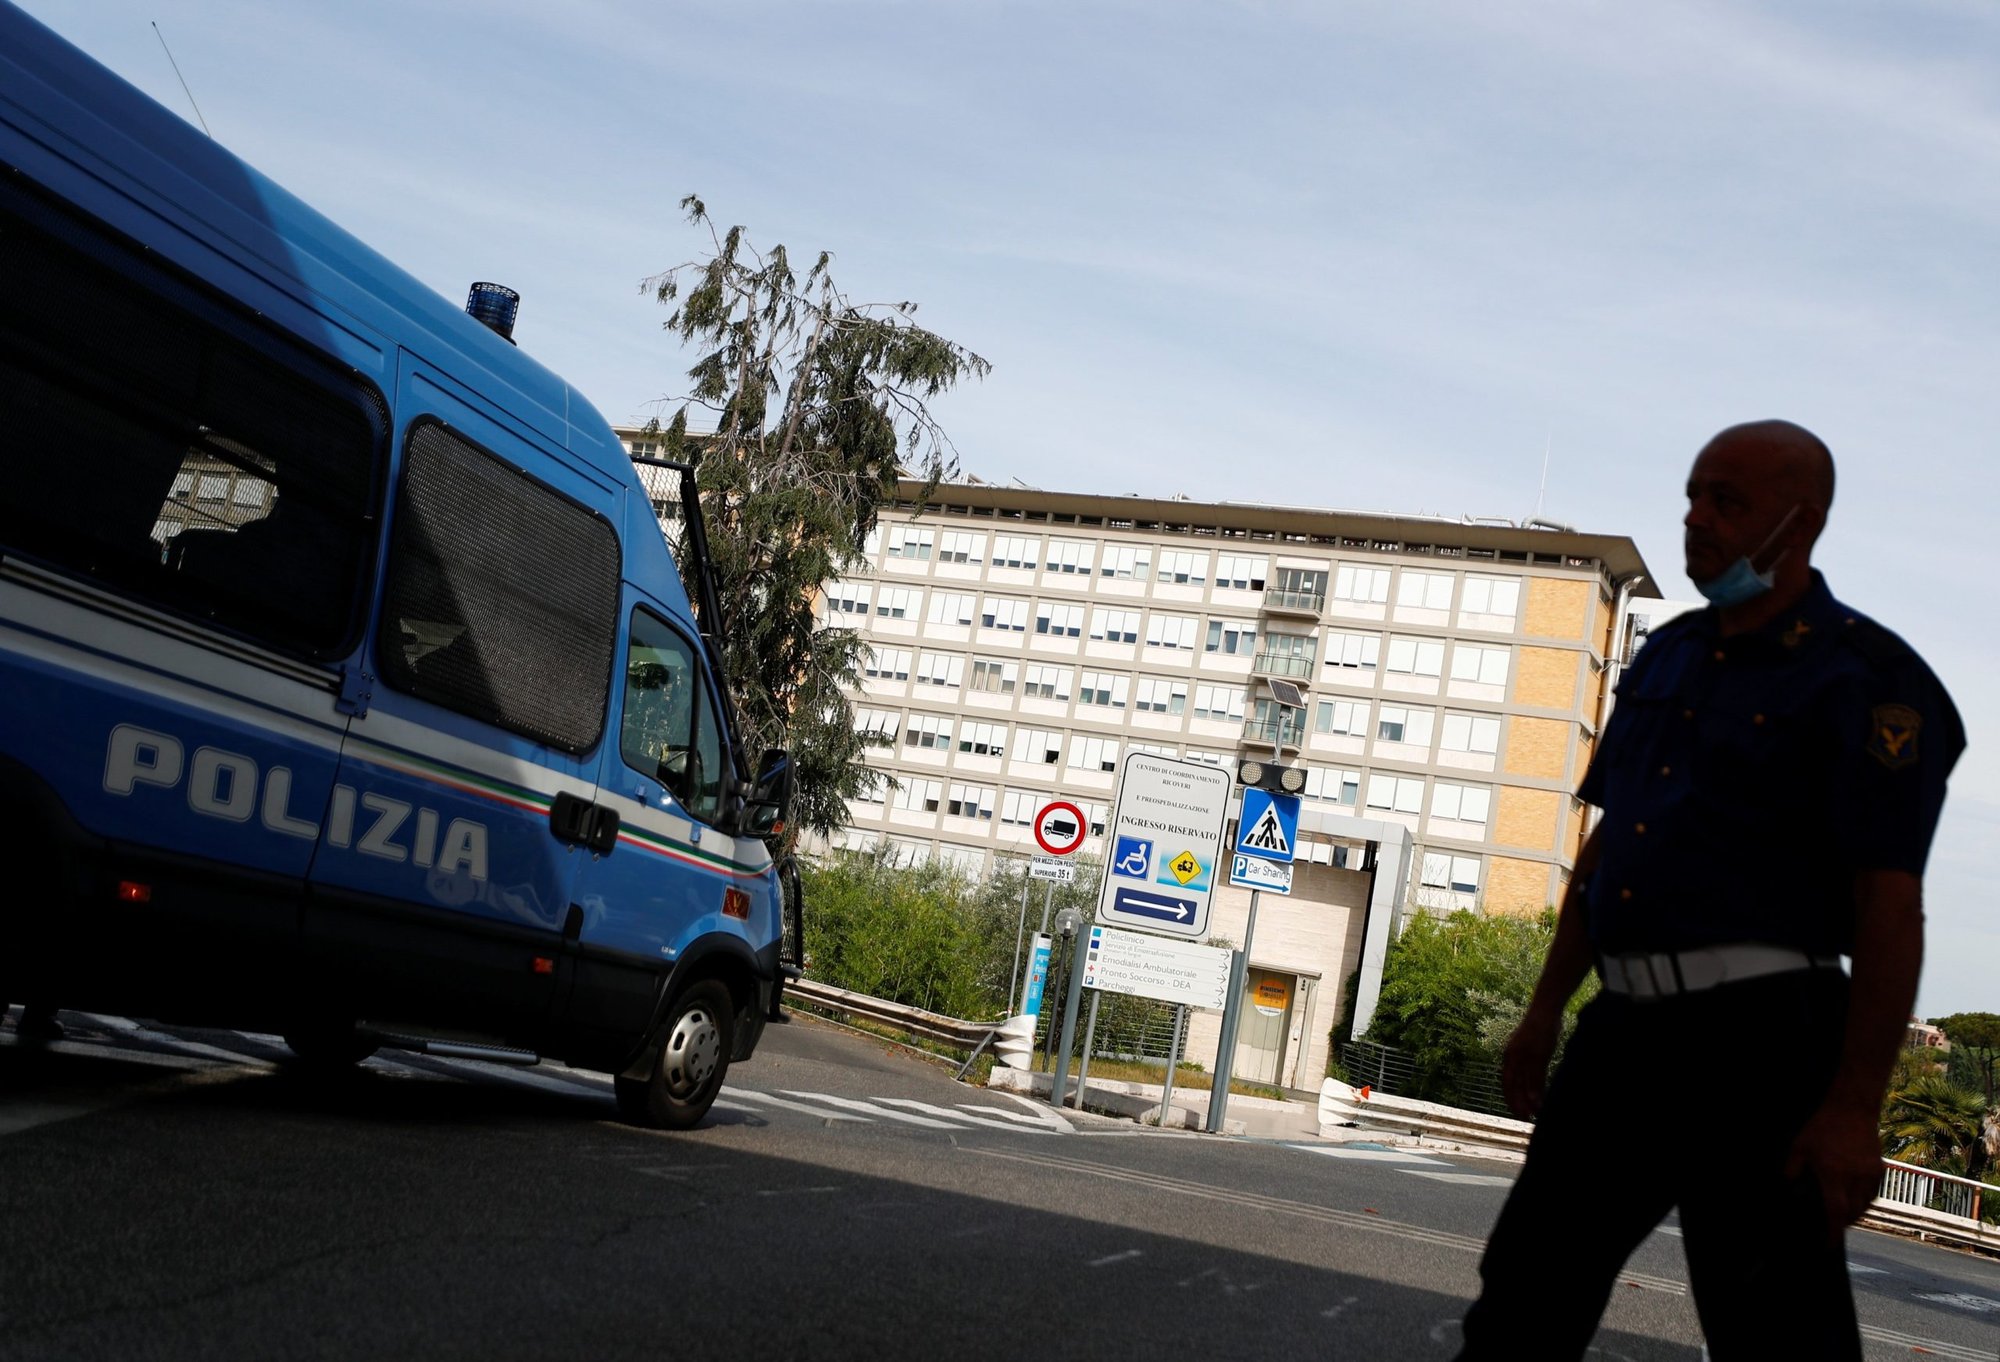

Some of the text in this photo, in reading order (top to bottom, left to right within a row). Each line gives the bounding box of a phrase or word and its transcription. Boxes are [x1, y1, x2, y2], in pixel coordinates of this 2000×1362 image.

[1136, 763, 1161, 774] CENTRO
[1168, 769, 1221, 785] COORDINAMENTO
[1162, 779, 1191, 790] RICOVERI
[103, 722, 489, 880] POLIZIA
[1141, 795, 1210, 814] PREOSPEDALIZZAZIONE
[1120, 815, 1217, 841] INGRESSO RISERVATO
[1041, 858, 1054, 866] MEZZI
[1063, 860, 1074, 868] PESO
[1248, 862, 1261, 874] Car
[1262, 865, 1291, 883] Sharing
[1034, 869, 1057, 878] SUPERIORE
[1057, 869, 1066, 879] 35
[1106, 931, 1145, 945] Policlinico
[1102, 955, 1198, 979] Emodialisi Ambulatoriale
[1098, 979, 1136, 994] Parcheggi
[1100, 967, 1127, 979] Pronto
[1129, 972, 1165, 986] Soccorso
[1172, 979, 1191, 990] DEA
